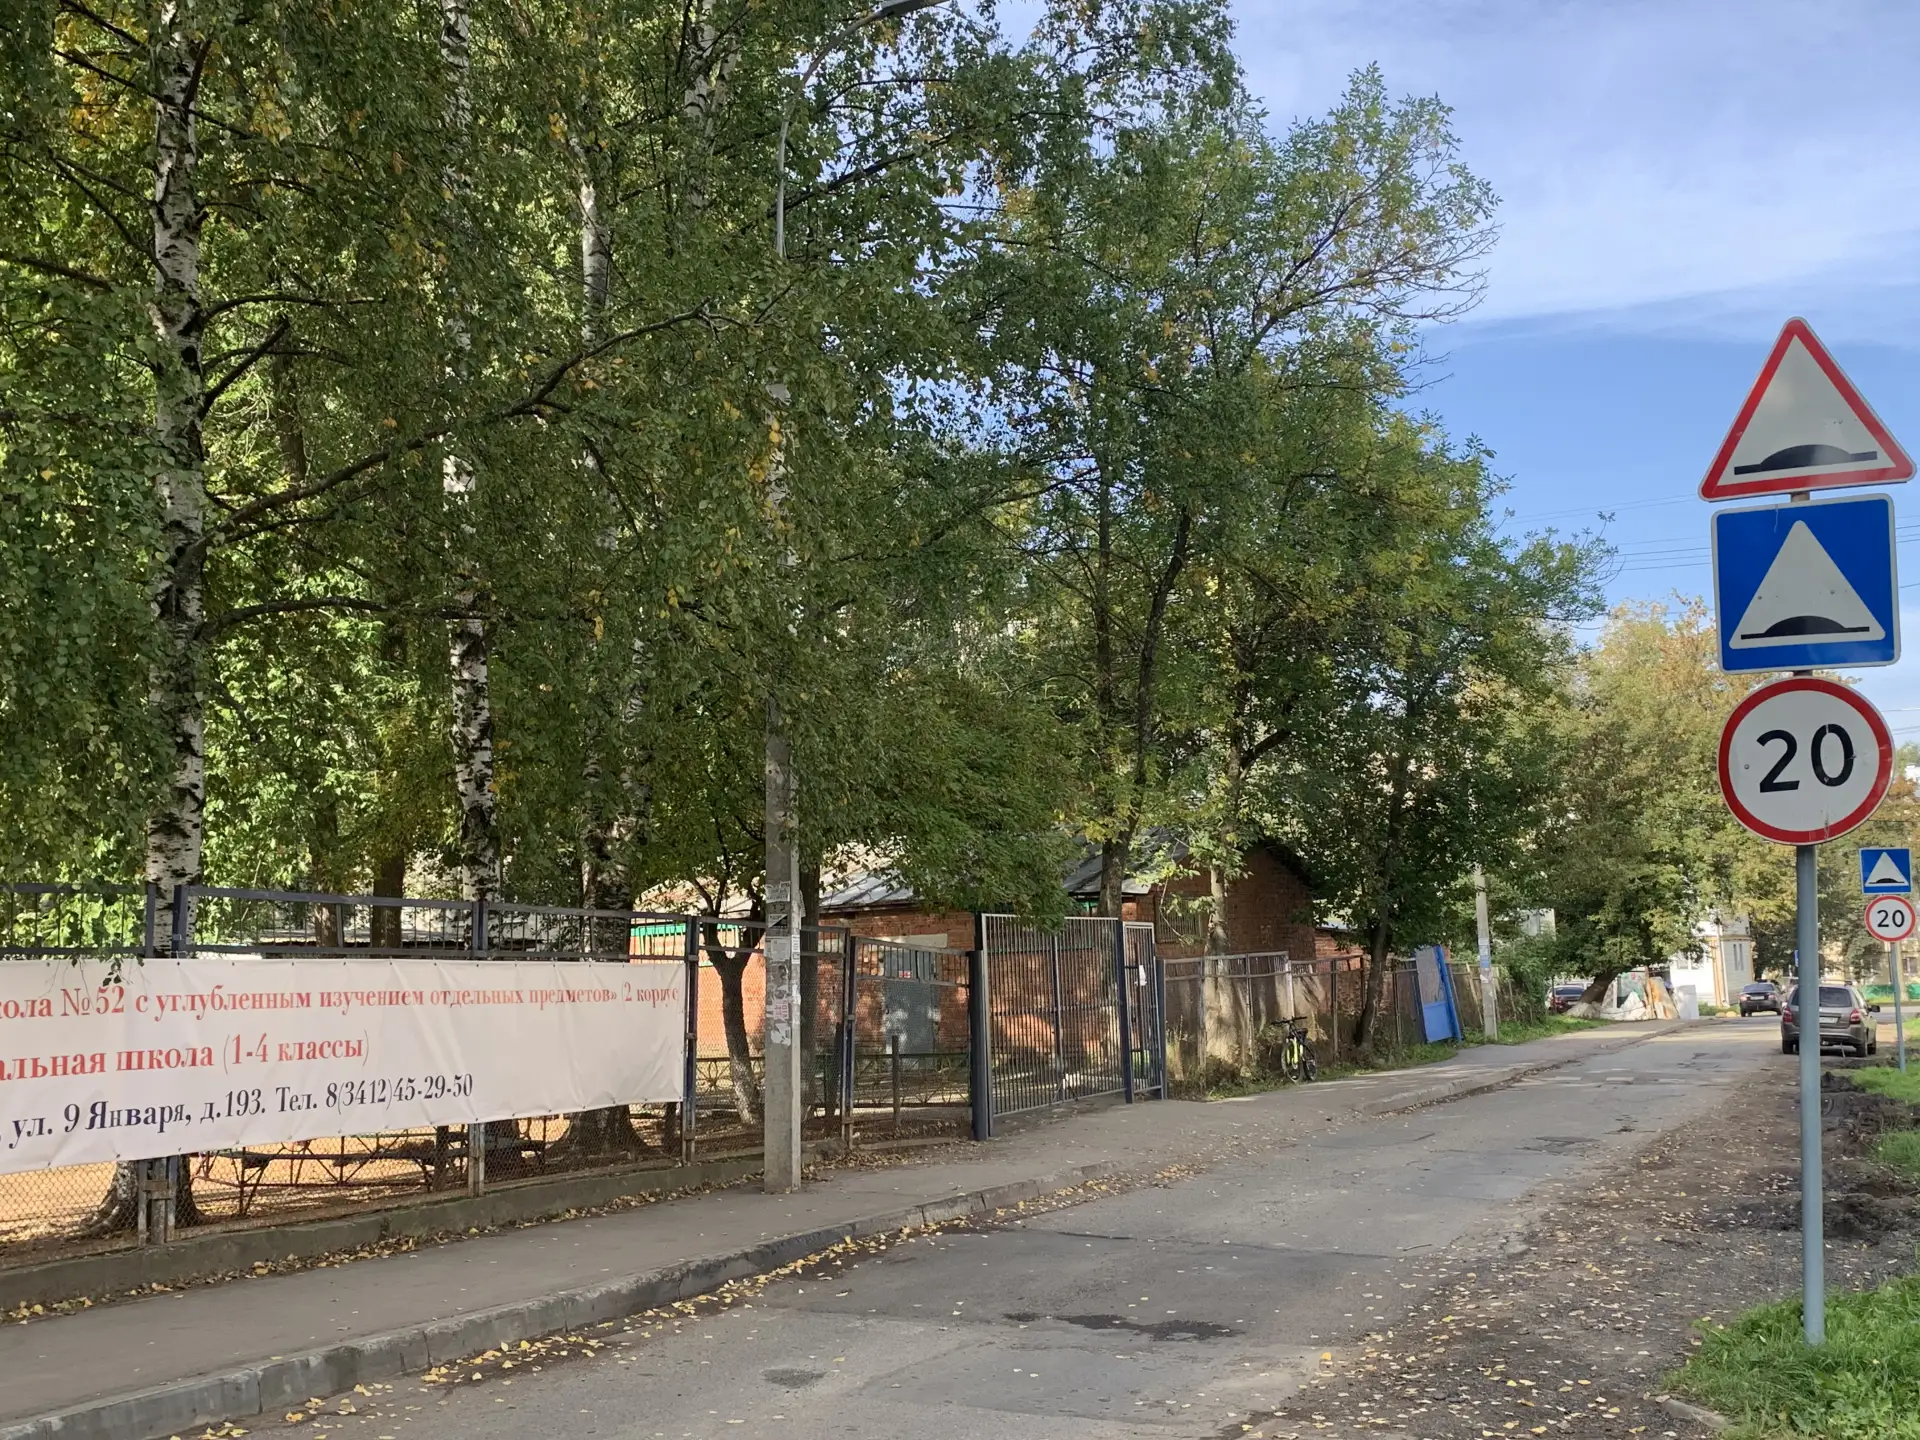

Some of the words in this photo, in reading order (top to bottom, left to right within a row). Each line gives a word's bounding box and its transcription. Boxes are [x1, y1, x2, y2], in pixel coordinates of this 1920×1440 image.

[1756, 723, 1855, 793] 20
[1876, 908, 1906, 929] 20
[0, 998, 52, 1019] ола
[135, 994, 149, 1013] с
[154, 984, 312, 1021] углубленным
[319, 987, 424, 1015] изучением
[430, 987, 524, 1009] отдельных
[528, 988, 618, 1010] предметов»
[116, 1045, 214, 1072] школа
[223, 1032, 269, 1075] (1-4
[276, 1030, 370, 1066] классы)
[8, 1117, 53, 1149] ул.
[63, 1103, 81, 1133] 9
[84, 1099, 192, 1133] Января,
[275, 1086, 318, 1113] Тел.
[325, 1072, 473, 1115] 8(3412)45-29-50
